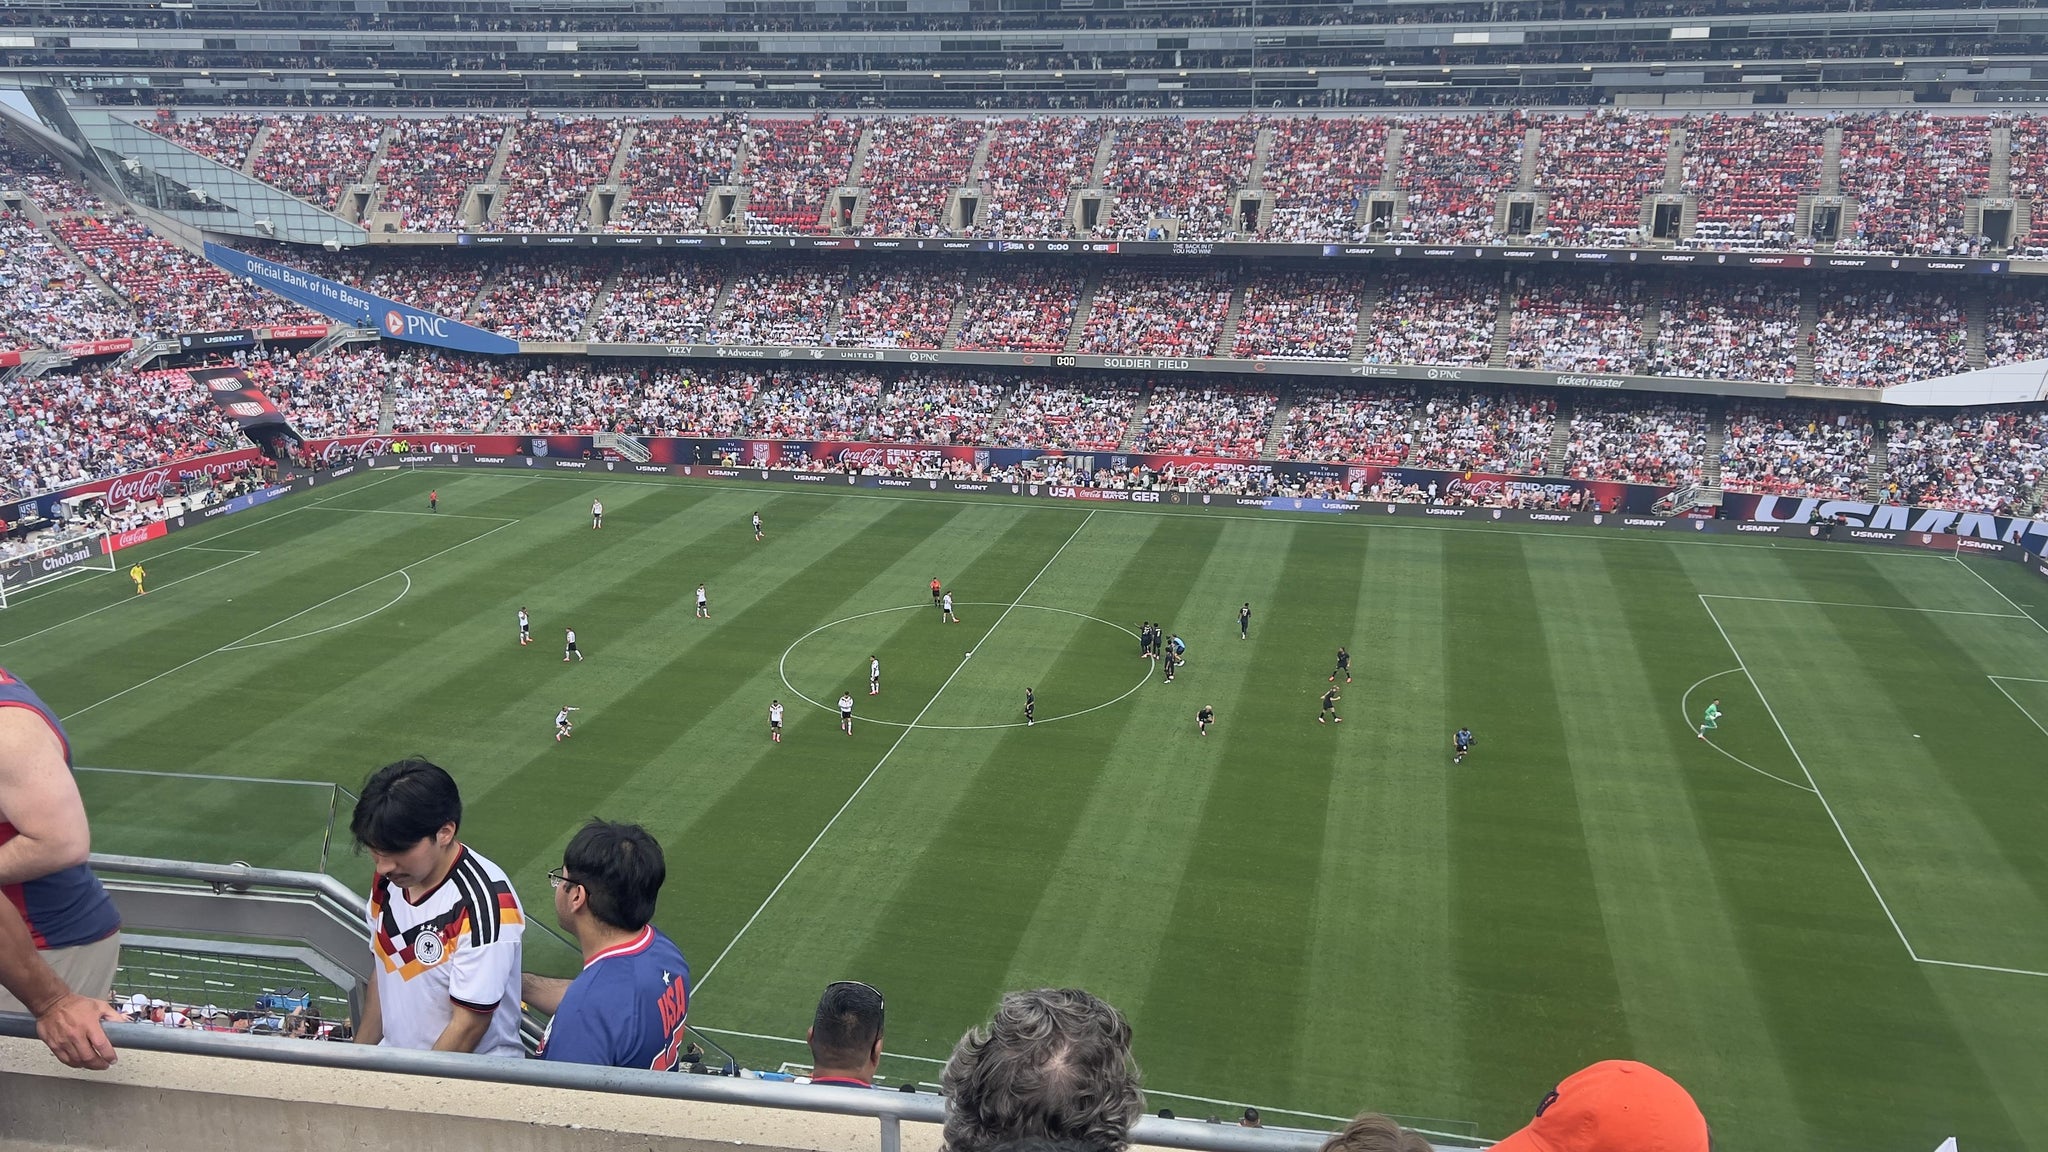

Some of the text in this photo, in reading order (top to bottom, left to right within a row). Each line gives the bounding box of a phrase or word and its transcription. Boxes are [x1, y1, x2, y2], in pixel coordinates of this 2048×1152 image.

[247, 260, 370, 311] Official Bank of the Bears
[405, 315, 449, 338] PNC
[204, 335, 244, 345] USMNT
[666, 346, 694, 354] VIZZY
[727, 349, 764, 358] Advocate
[1104, 358, 1189, 370] SOLDIER FIELD
[1440, 370, 1462, 379] PNC
[399, 456, 434, 464] USMNT
[556, 460, 586, 468] USMNT
[332, 465, 355, 478] USMNT
[635, 465, 667, 473] USMNT
[1213, 462, 1272, 473] SEND-OFF
[708, 469, 740, 477] USMNT
[878, 479, 911, 487] USMNT
[954, 483, 988, 491] USMNT
[266, 485, 293, 498] USMNT
[1049, 486, 1076, 498] USA
[1079, 489, 1101, 498] Coca-Cola
[1132, 491, 1160, 502] GER
[1236, 498, 1273, 507] USMNT
[1322, 503, 1360, 511] USMNT
[205, 503, 233, 517] USMNT
[1425, 508, 1465, 516] USMNT
[1530, 513, 1571, 522] USMNT
[1624, 518, 1666, 527] USMNT
[1737, 524, 1780, 533] USMNT
[119, 527, 148, 547] Coca-Cola
[1850, 530, 1896, 541] USMNT
[1957, 538, 2005, 552] USMNT
[42, 546, 91, 571] Chobani
[657, 975, 686, 1039] USA
